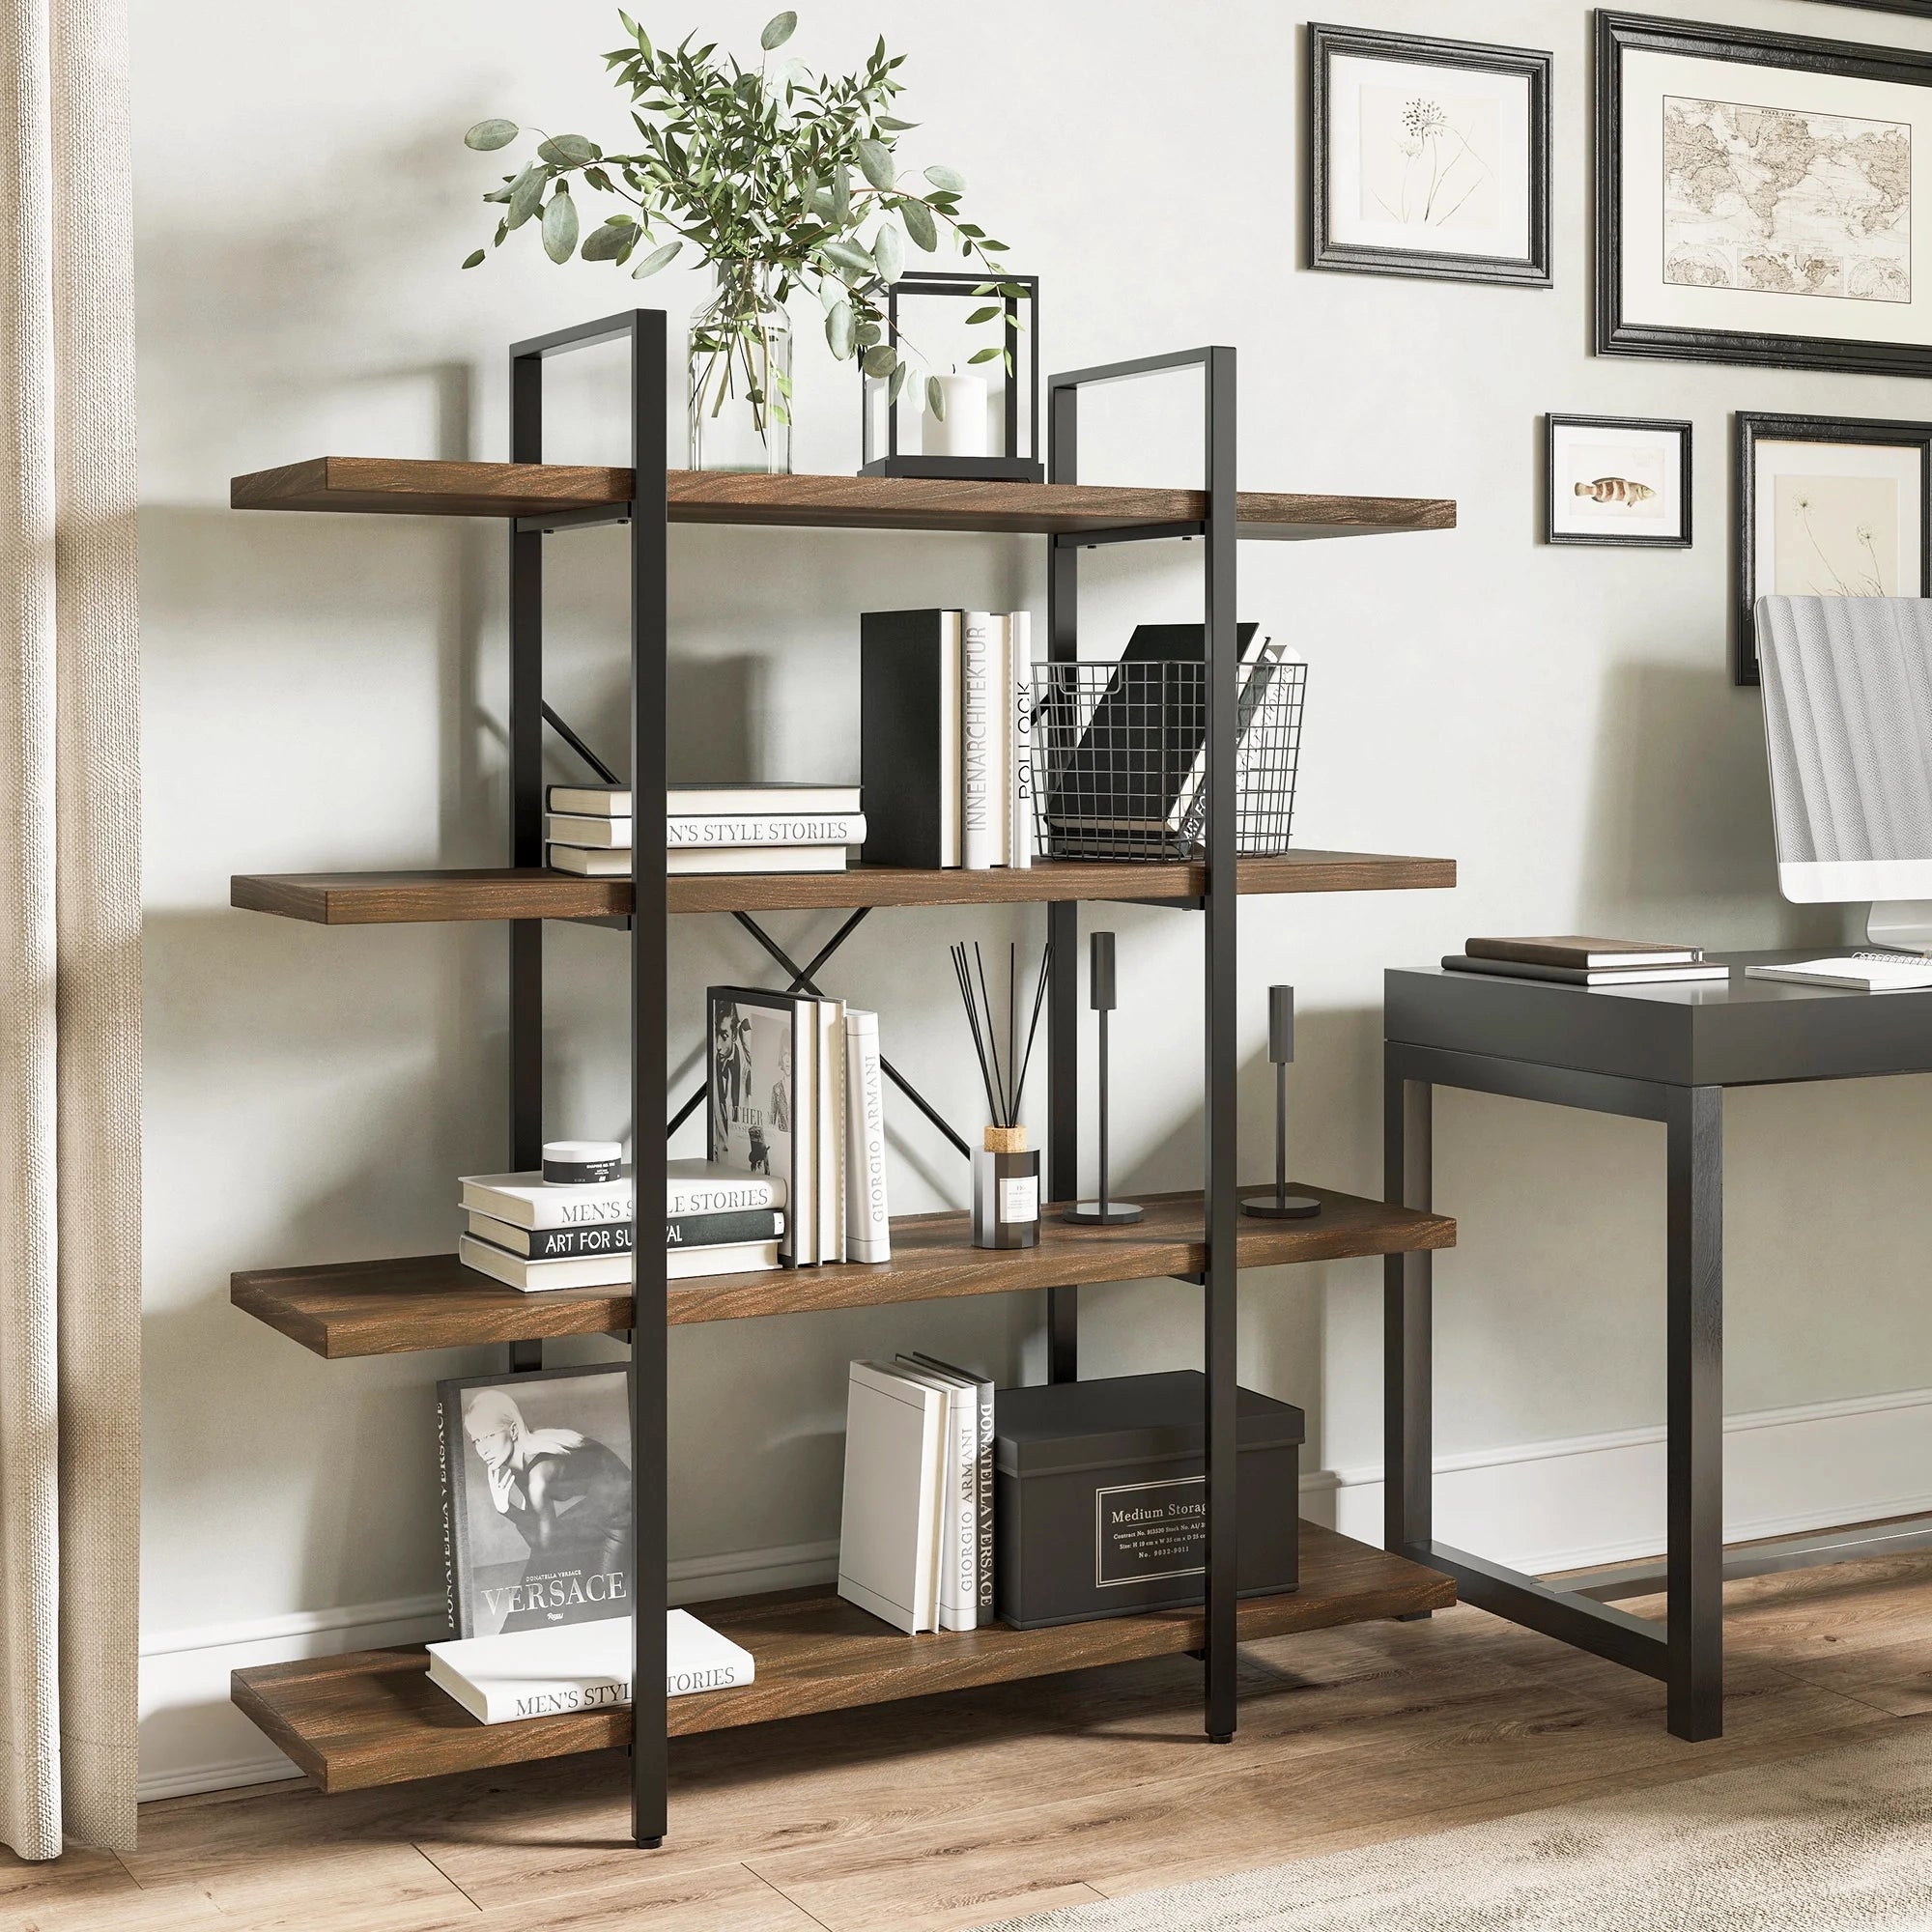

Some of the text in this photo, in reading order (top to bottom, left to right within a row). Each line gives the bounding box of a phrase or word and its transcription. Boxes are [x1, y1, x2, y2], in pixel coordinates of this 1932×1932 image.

[966, 626, 986, 832] INNENARCHITEKTUR
[667, 821, 847, 842] N'S STYLE STORIES
[866, 1056, 884, 1222] GIORGIO ARMANI
[561, 1202, 620, 1223] MEN'S
[691, 1188, 768, 1211] STORIES
[545, 1233, 574, 1254] ART
[580, 1231, 611, 1250] FOR
[961, 1429, 973, 1592] GIORGIO ARMANI
[980, 1403, 993, 1606] DONATELLA VERSACE
[1112, 1503, 1206, 1523] Medium Storag
[481, 1572, 627, 1616] VERSACE
[526, 1569, 582, 1581] DONATELLA VERSACE
[516, 1666, 735, 1717] MEN'S STYL TORIES
